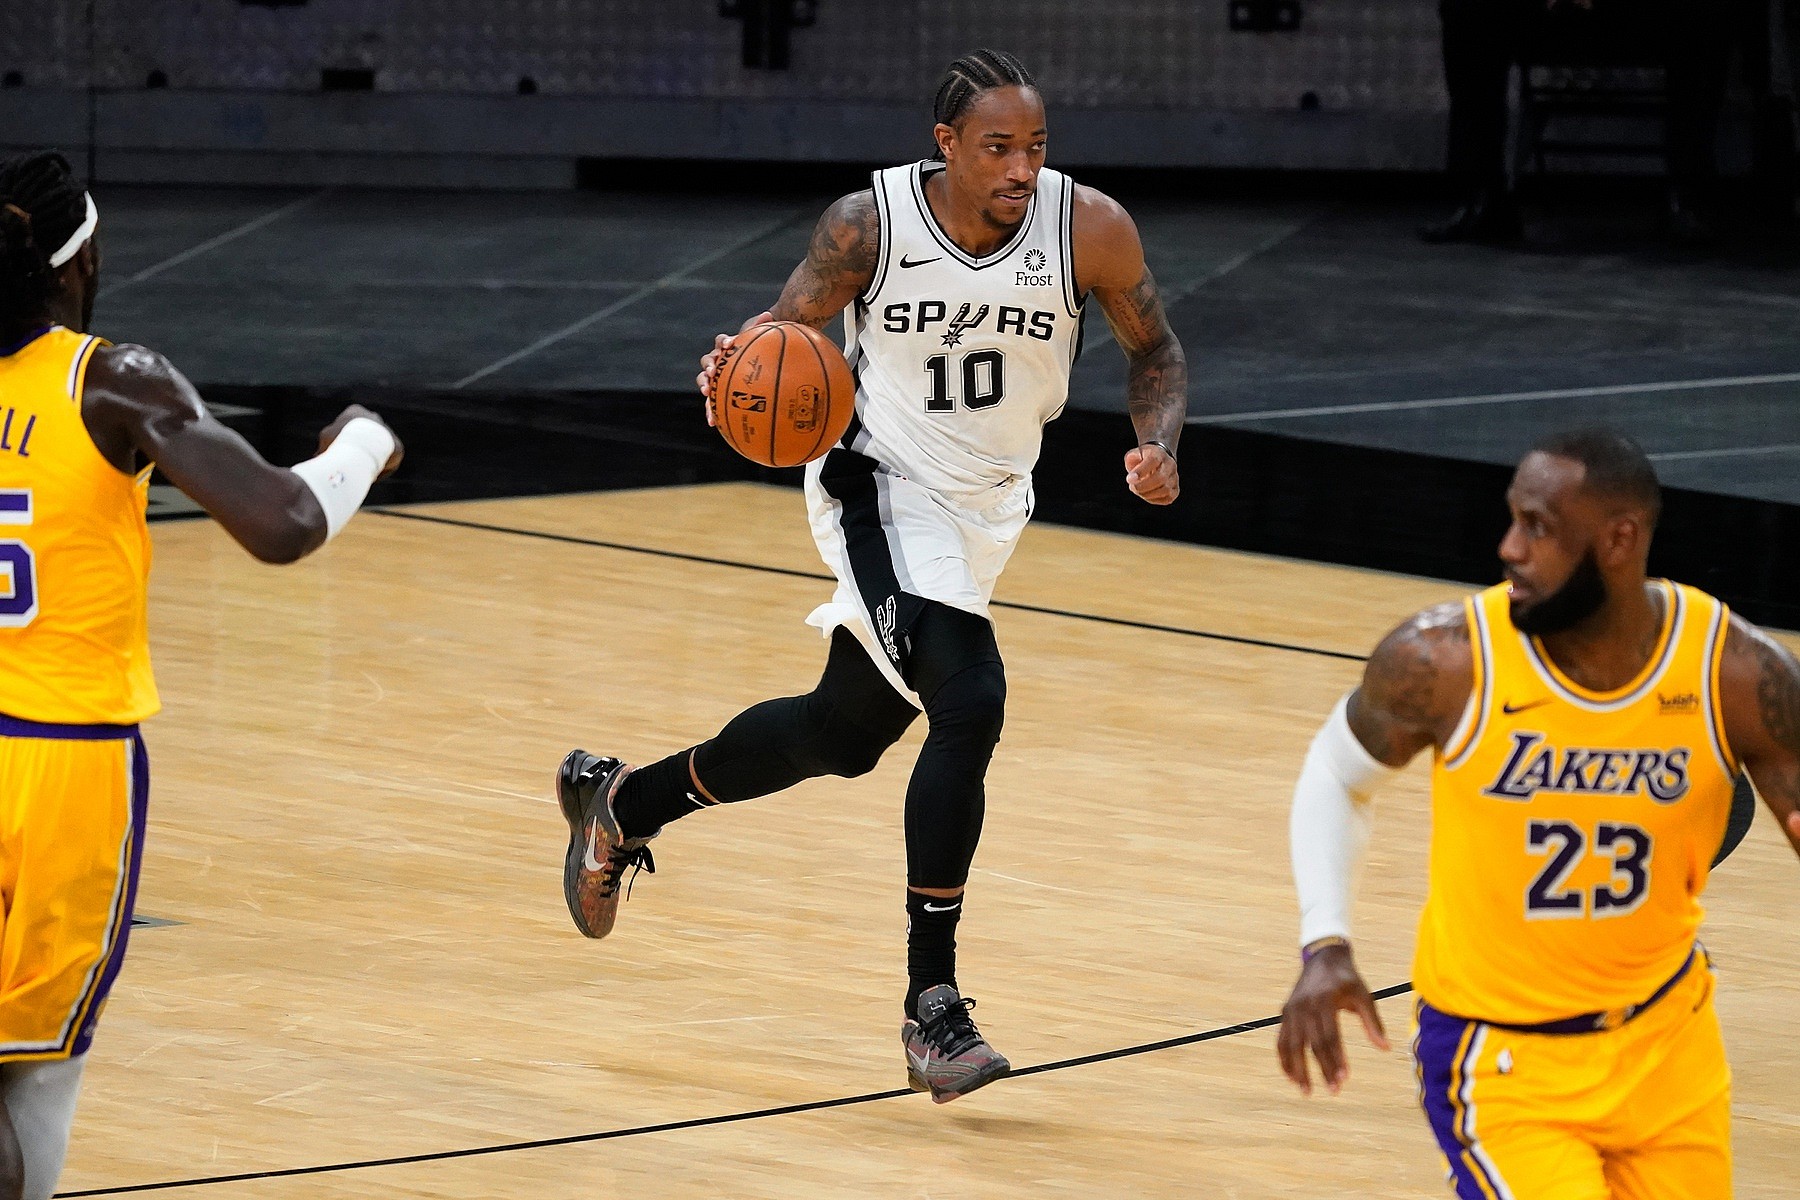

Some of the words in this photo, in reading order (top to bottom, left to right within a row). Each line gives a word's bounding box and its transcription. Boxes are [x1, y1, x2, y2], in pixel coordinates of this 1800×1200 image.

[1014, 271, 1053, 287] Frost
[883, 301, 1056, 349] SPURS
[924, 348, 1006, 413] 10
[0, 405, 36, 457] LL
[1482, 730, 1690, 804] LAKERS
[1525, 817, 1654, 921] 23
